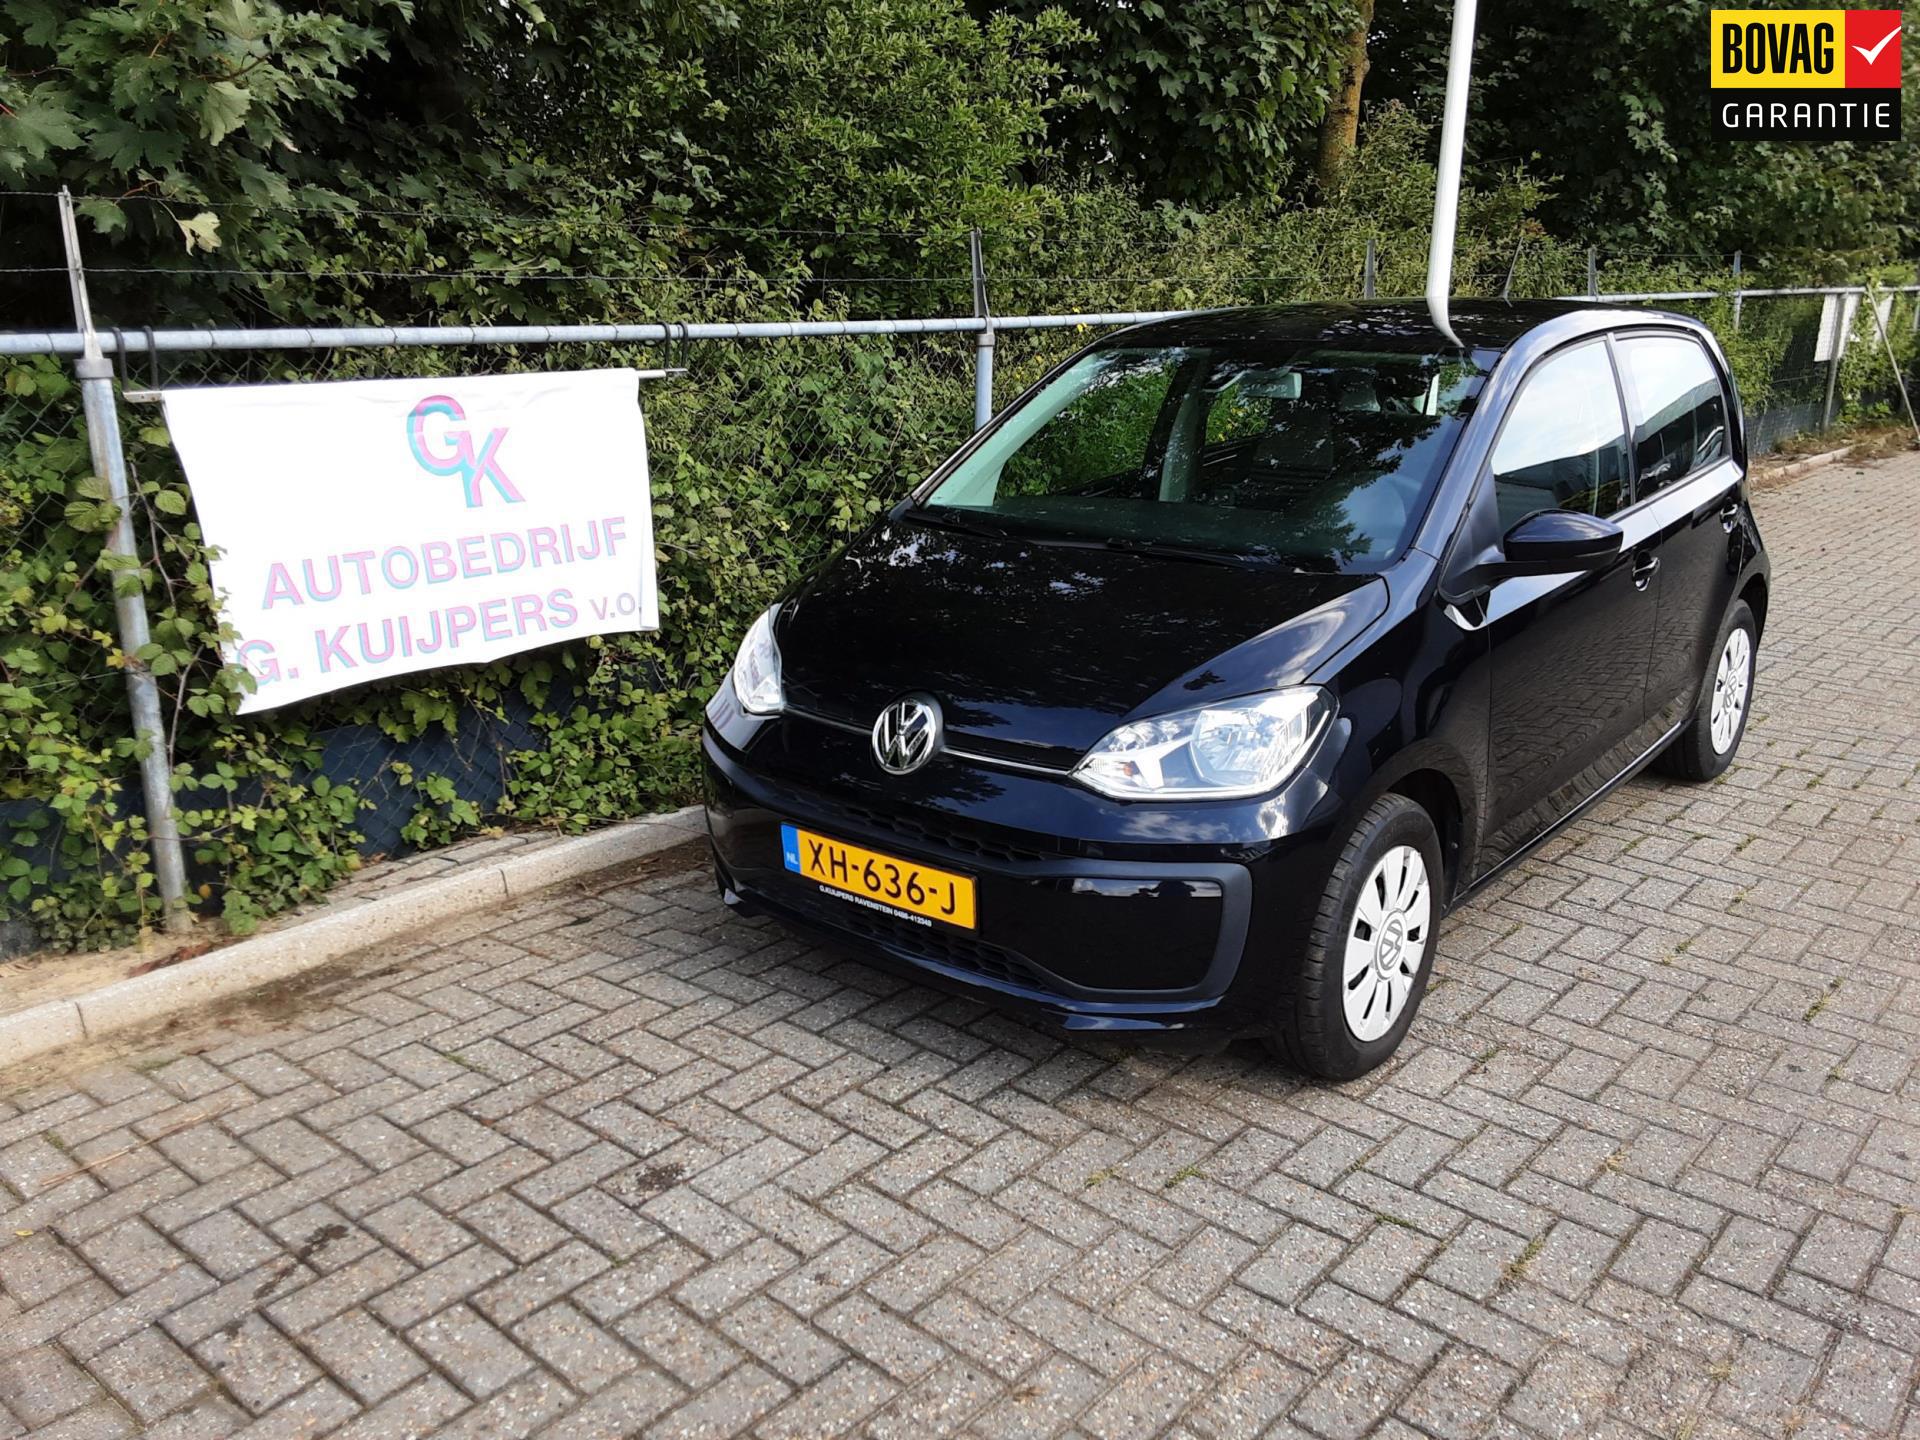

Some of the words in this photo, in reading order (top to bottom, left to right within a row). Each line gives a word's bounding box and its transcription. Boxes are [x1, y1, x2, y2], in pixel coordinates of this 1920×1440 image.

[406, 394, 526, 508] GK
[262, 516, 627, 610] AUTOBEDRIJF
[236, 639, 300, 686] G.
[314, 588, 578, 674] KUIJPERS
[786, 852, 799, 865] NL
[808, 838, 956, 915] XH-636-J
